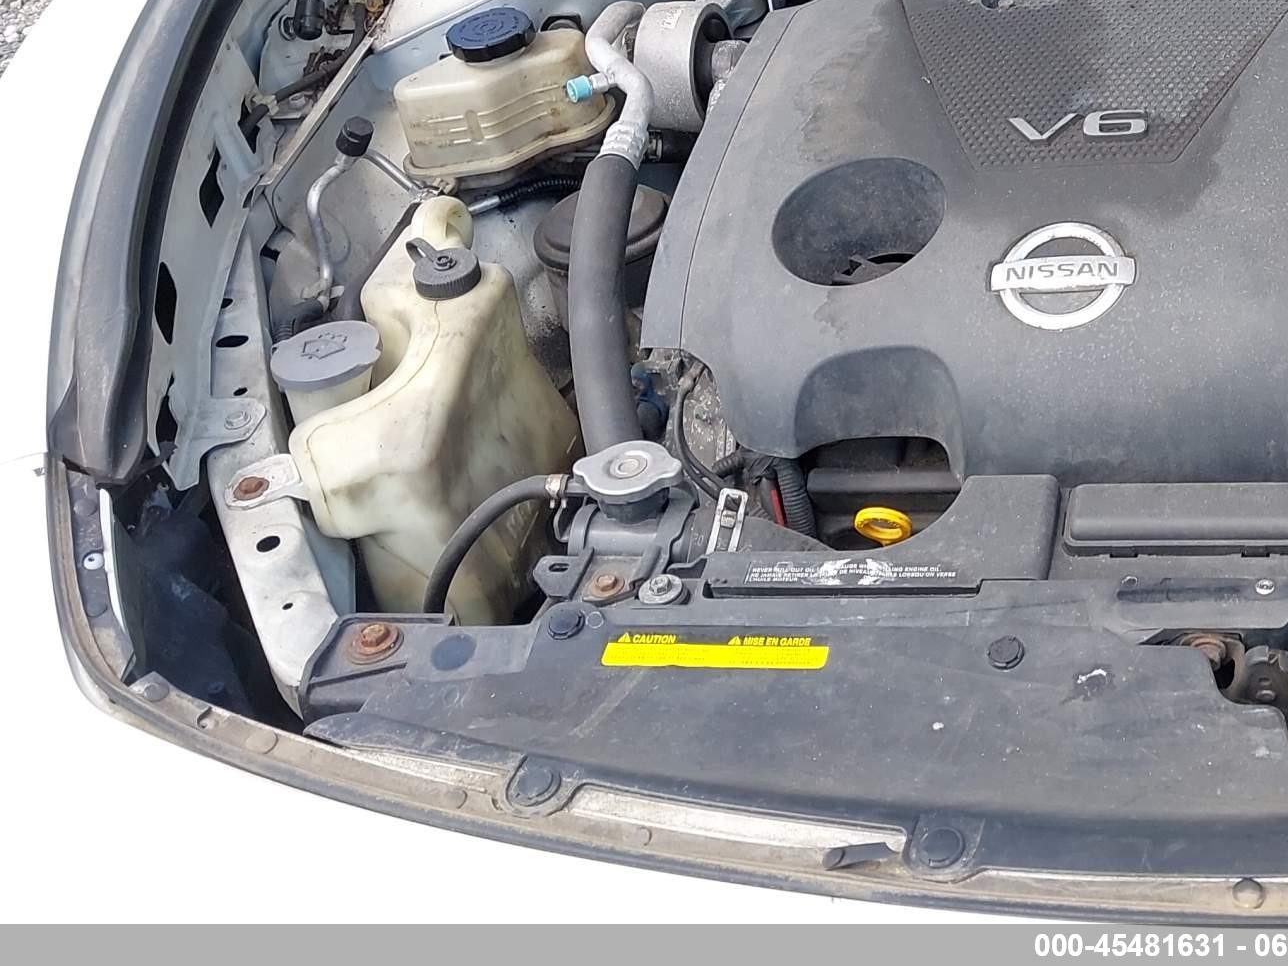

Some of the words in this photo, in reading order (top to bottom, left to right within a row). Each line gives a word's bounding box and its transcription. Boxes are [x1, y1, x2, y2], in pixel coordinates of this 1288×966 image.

[1008, 109, 1148, 140] V6
[1005, 262, 1118, 282] NISSAN
[632, 634, 676, 644] CAUTION
[743, 636, 765, 645] MISE
[766, 637, 778, 645] EN
[780, 637, 811, 646] GARDE
